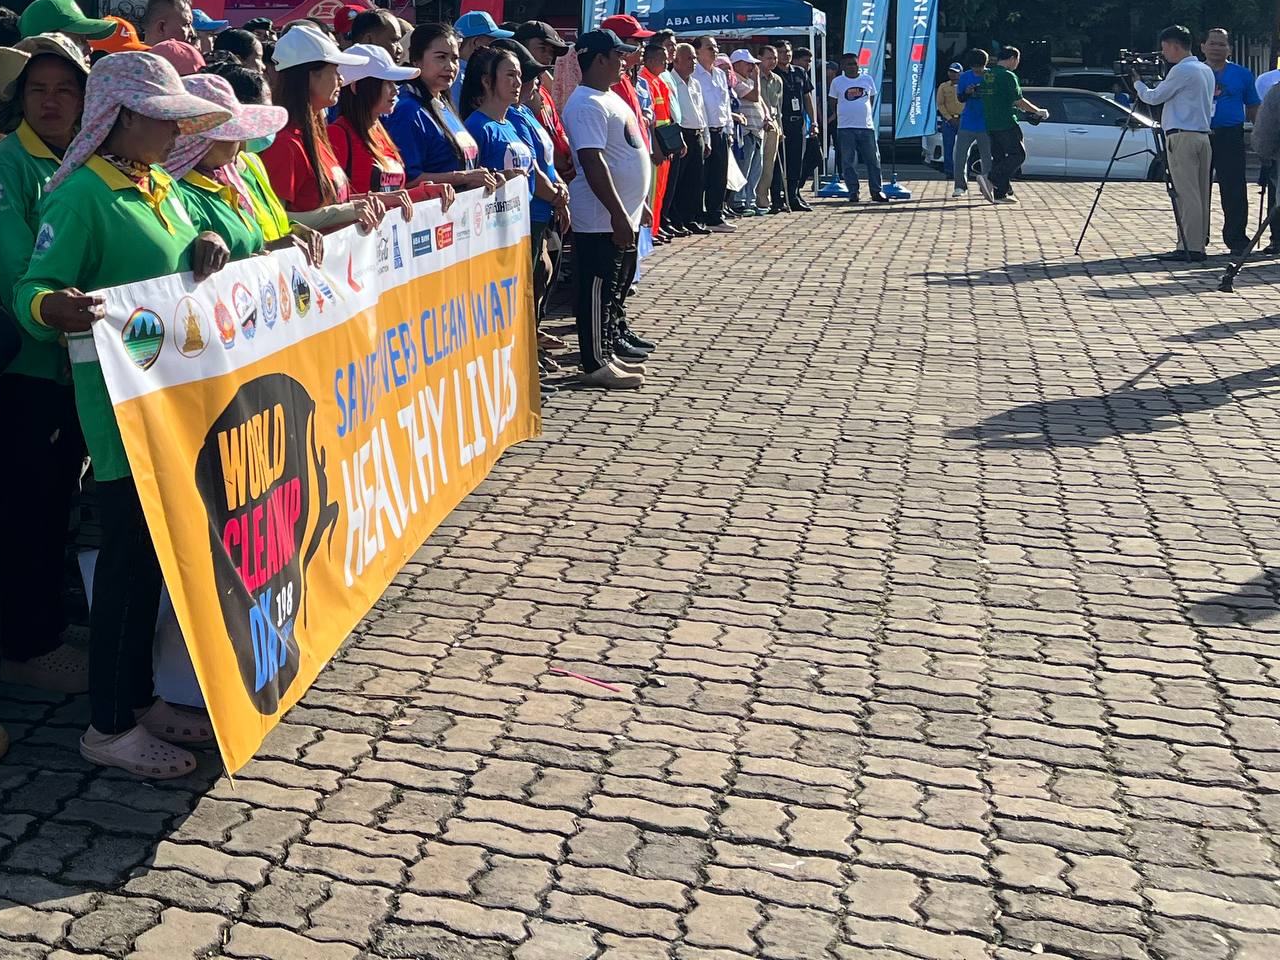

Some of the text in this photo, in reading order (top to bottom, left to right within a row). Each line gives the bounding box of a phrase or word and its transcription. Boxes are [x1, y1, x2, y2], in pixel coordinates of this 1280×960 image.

[666, 14, 729, 26] ABA BANK
[420, 293, 468, 366] CLEAN
[217, 403, 286, 512] WORLD
[341, 377, 449, 587] HEALTHY
